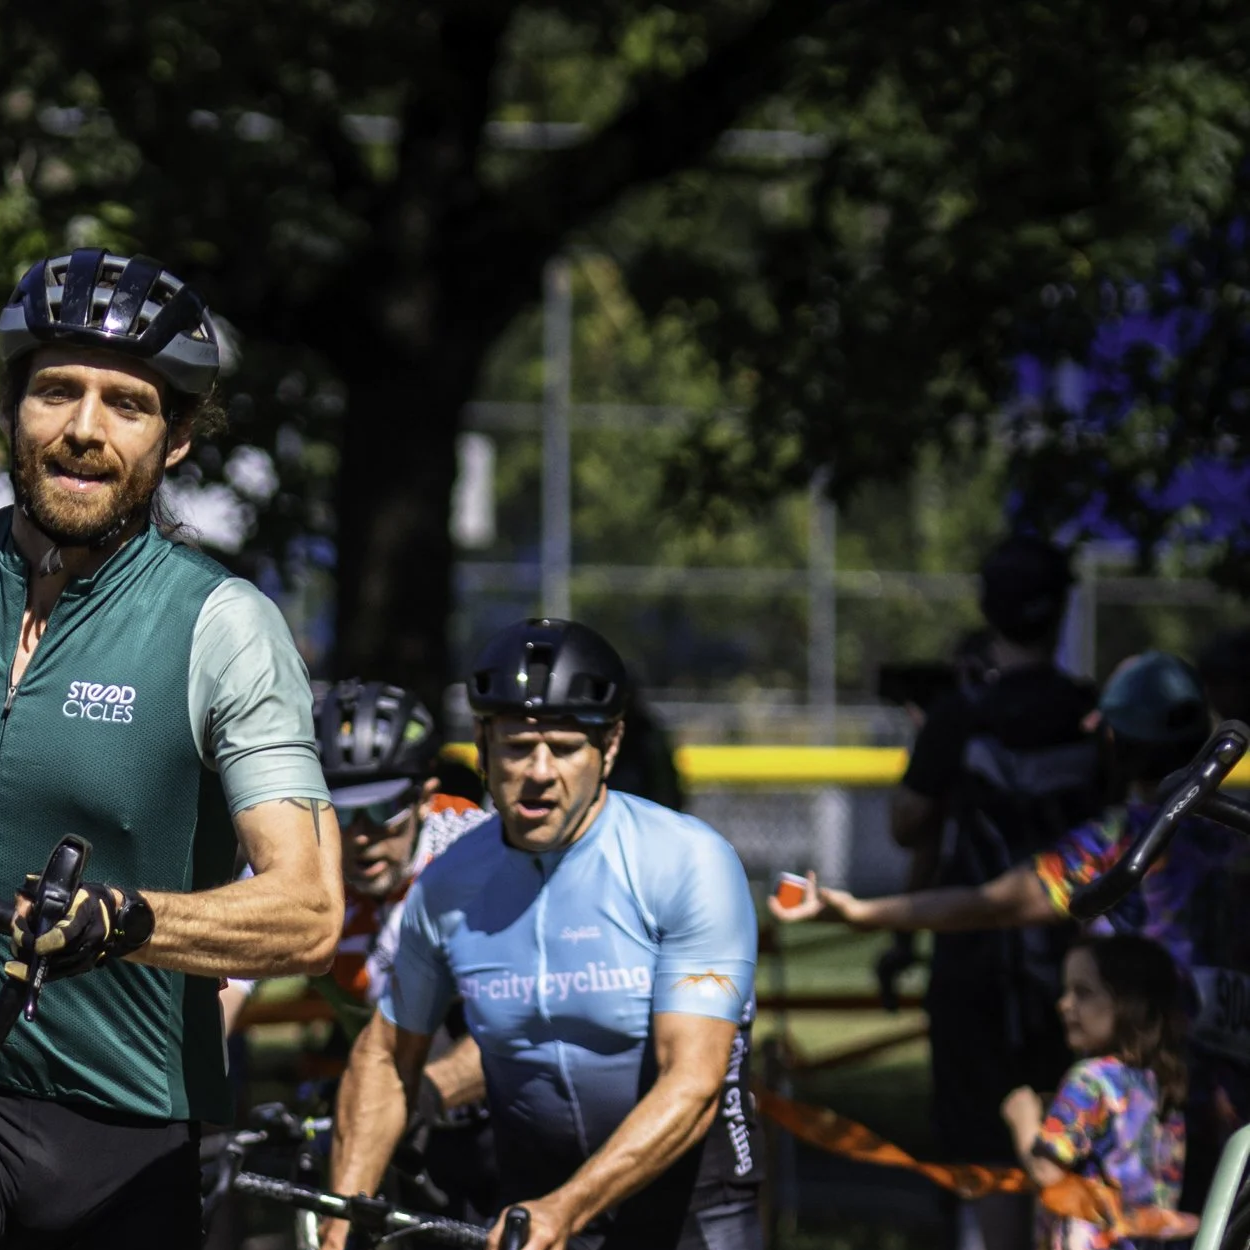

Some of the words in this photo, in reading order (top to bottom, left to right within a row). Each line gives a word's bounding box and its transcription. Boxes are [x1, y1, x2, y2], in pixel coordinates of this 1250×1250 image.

[62, 699, 134, 724] CYCLES
[1165, 784, 1200, 821] GRX
[538, 961, 651, 1001] cycling
